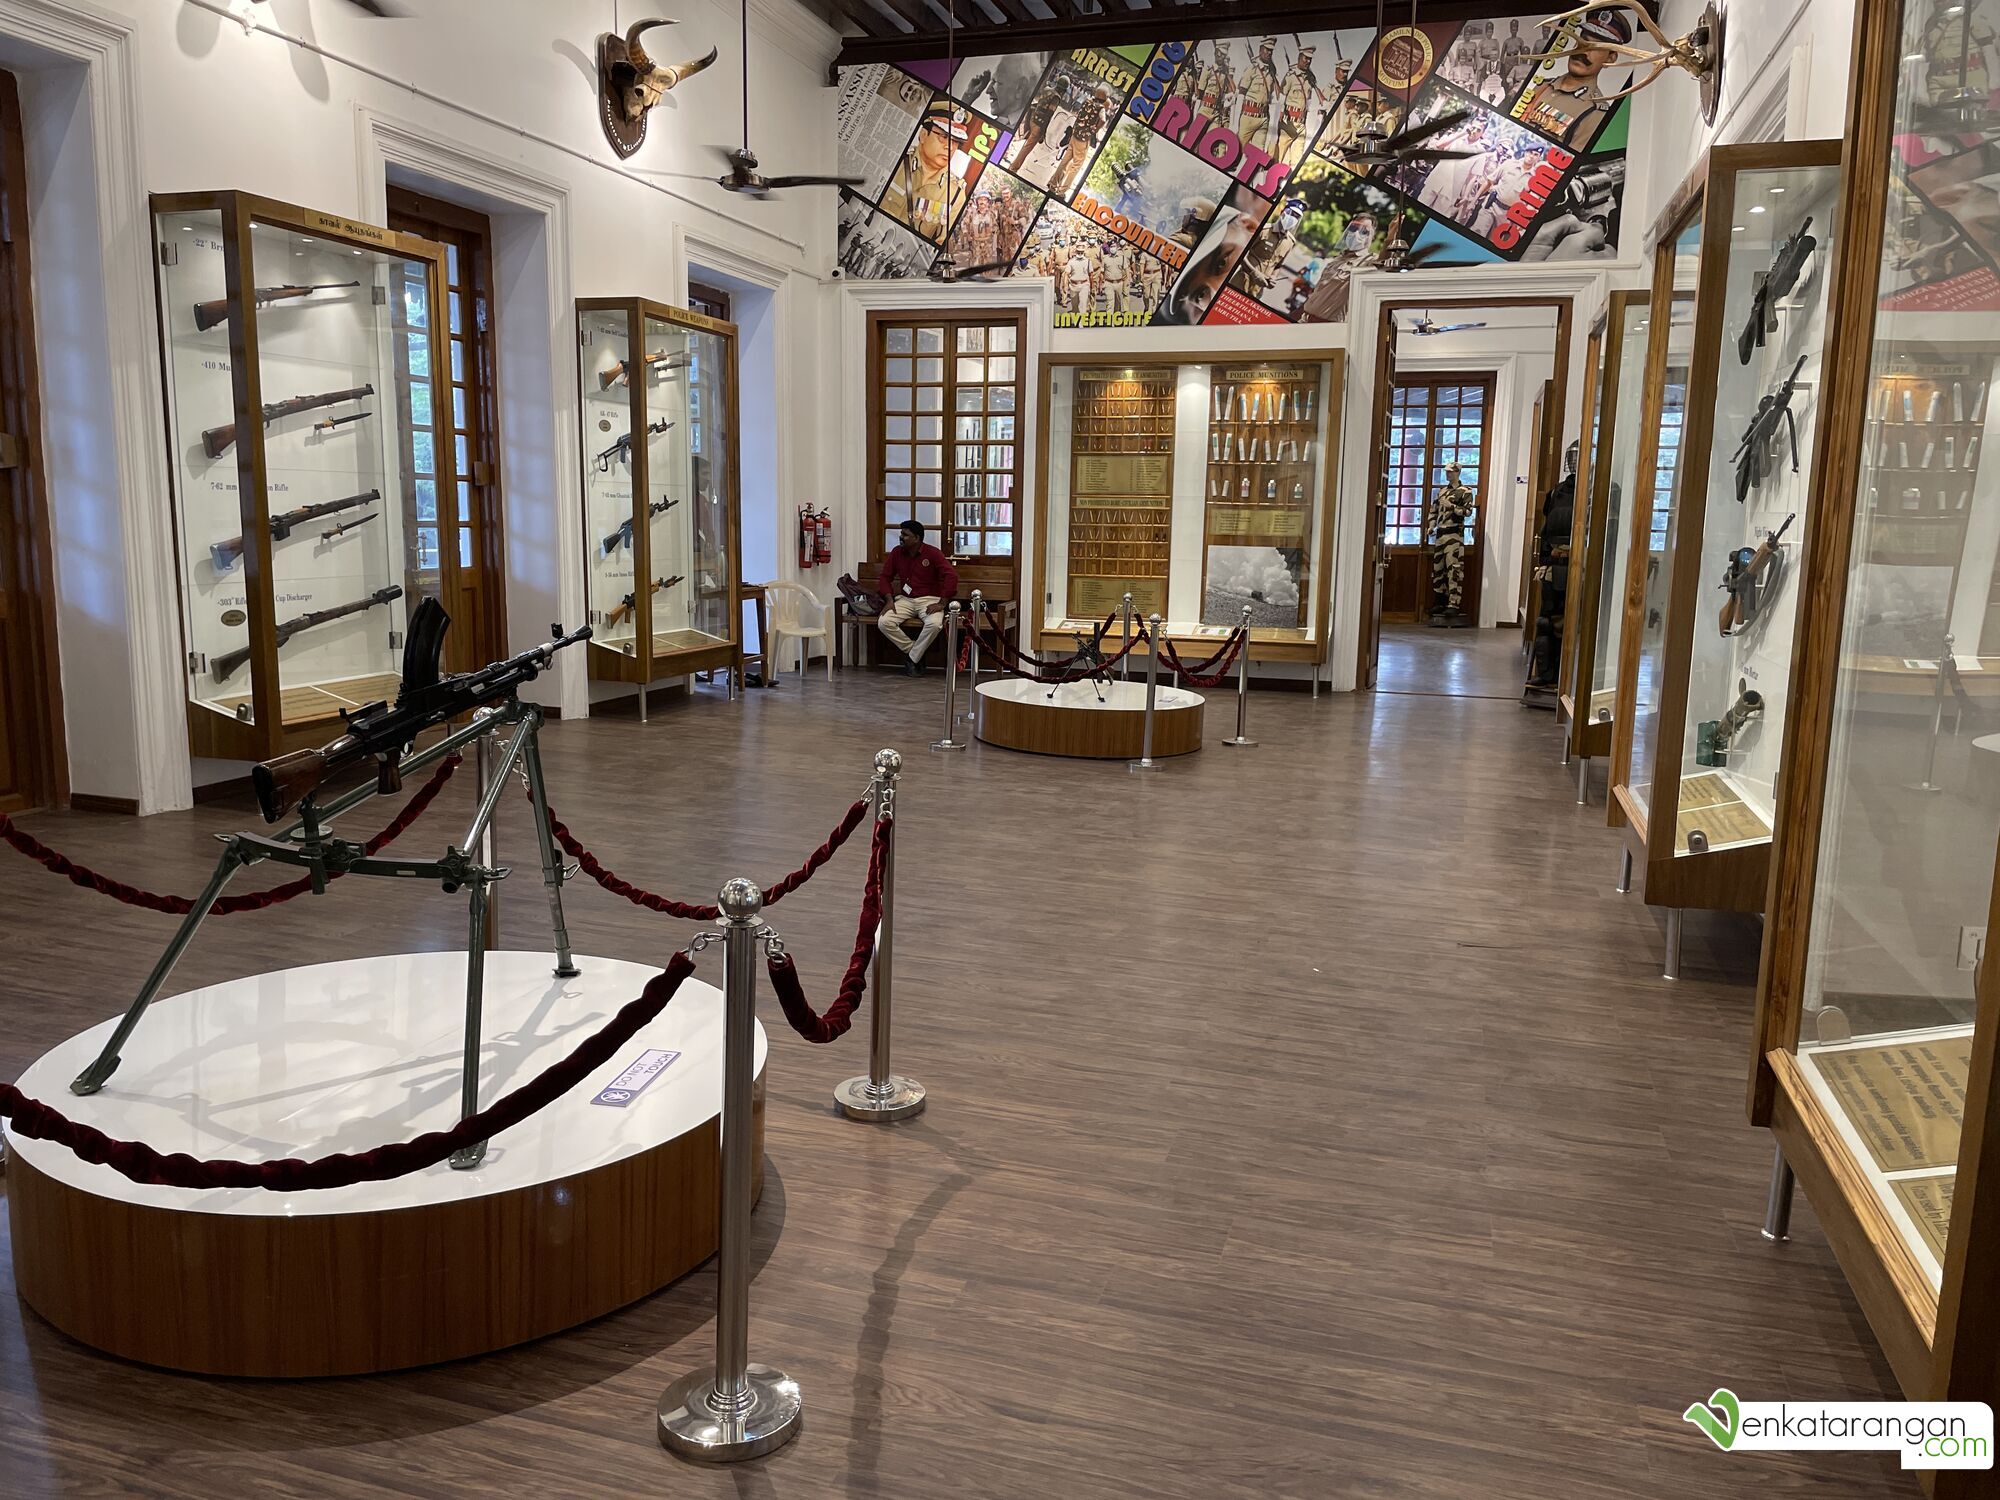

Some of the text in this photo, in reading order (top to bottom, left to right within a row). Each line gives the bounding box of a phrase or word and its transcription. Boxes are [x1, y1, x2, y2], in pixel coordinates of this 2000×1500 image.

[1070, 48, 1136, 93] ARREST
[1129, 41, 1186, 121] 2006
[1509, 88, 1536, 118] LAW
[1533, 75, 1544, 85] &
[968, 121, 998, 163] IPS
[1153, 96, 1292, 198] RIOTS
[1491, 146, 1575, 250] CRIME
[1070, 192, 1189, 269] ENCOUNTER
[1055, 310, 1154, 328] INVESTIGATE
[1229, 371, 1298, 379] POLICE MUNITIONS
[616, 1062, 647, 1087] DO NOT
[643, 1053, 673, 1075] TOUCH
